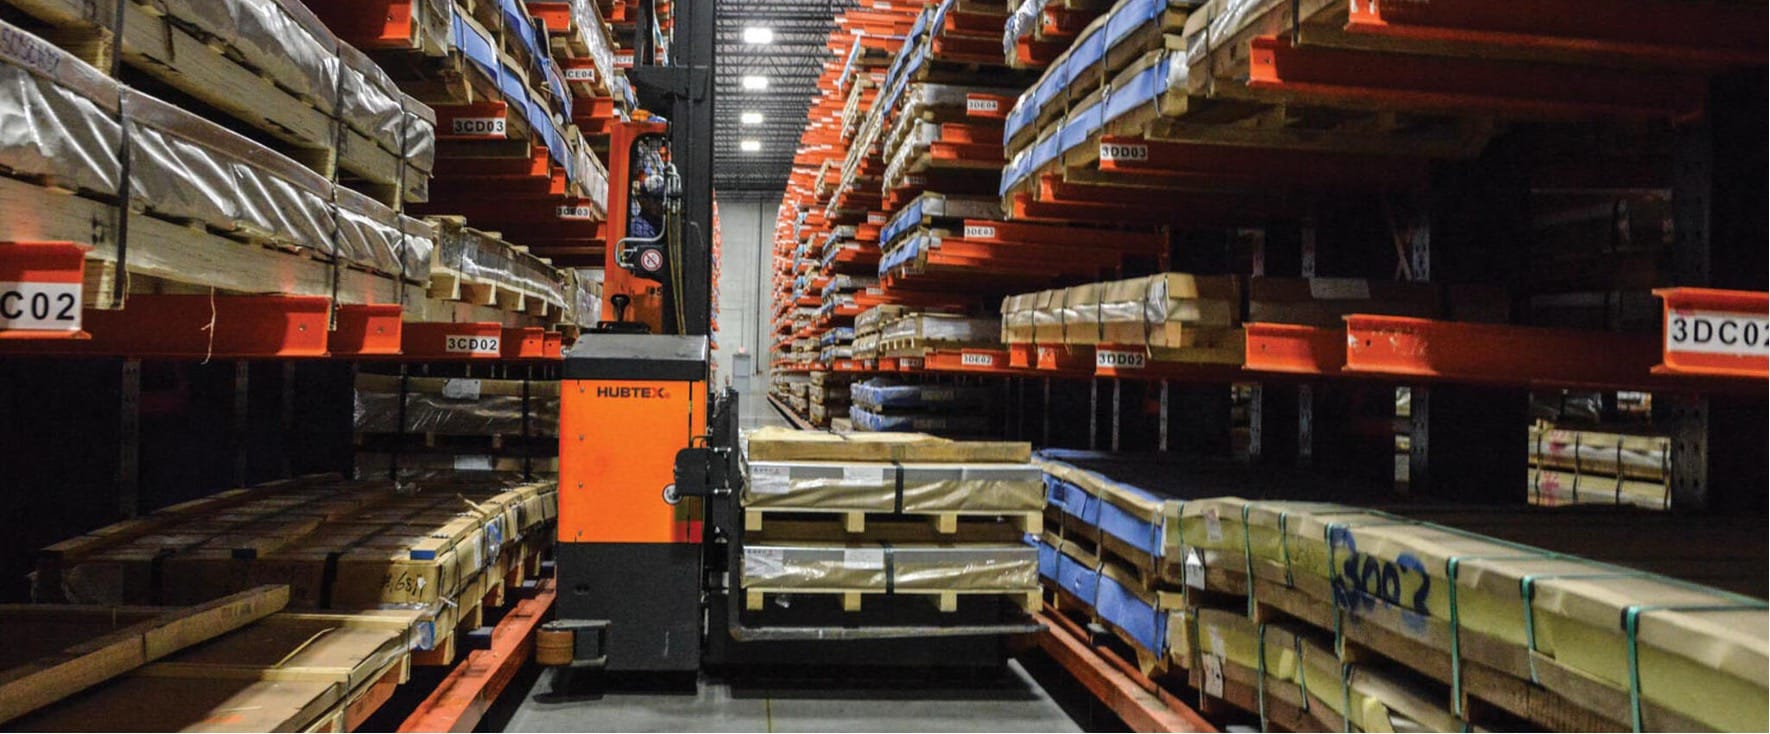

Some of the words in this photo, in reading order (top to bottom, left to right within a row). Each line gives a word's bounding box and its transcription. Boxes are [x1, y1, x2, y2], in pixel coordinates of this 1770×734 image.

[968, 100, 997, 109] 3DE04
[455, 121, 504, 132] 3CD03
[1101, 145, 1146, 158] 3DD03
[448, 338, 497, 350] 3CD02
[963, 355, 991, 364] 3DE02
[1098, 353, 1144, 366] 3DD02
[597, 387, 665, 398] HUBTEX
